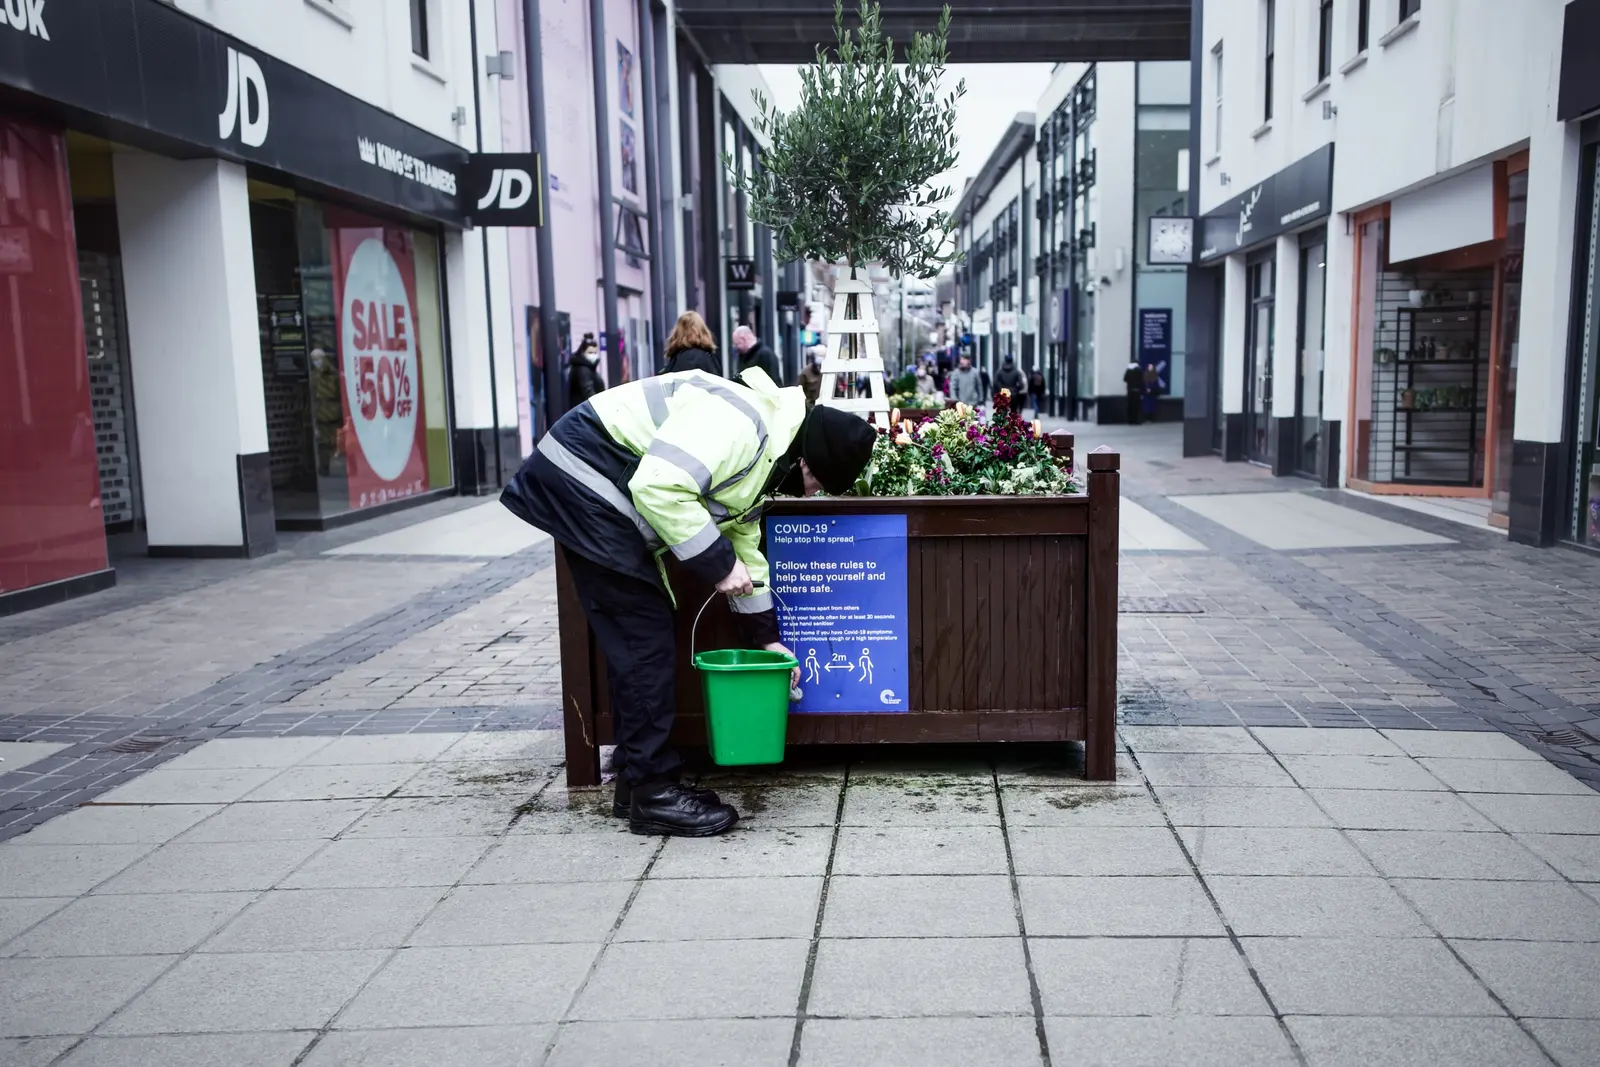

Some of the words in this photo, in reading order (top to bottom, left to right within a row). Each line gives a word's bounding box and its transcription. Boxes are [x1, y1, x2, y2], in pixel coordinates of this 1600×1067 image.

[219, 46, 269, 148] JD
[377, 142, 404, 176] KING
[403, 154, 413, 172] OF
[478, 169, 532, 210] JD
[732, 265, 750, 279] W
[352, 298, 408, 352] SALE
[360, 356, 410, 420] 50%
[397, 400, 412, 418] OFF
[775, 524, 828, 533] COVID-19
[775, 536, 792, 544] Help
[776, 562, 807, 570] Follow
[810, 561, 837, 569] these
[840, 561, 864, 569] rules
[776, 573, 797, 583] help
[800, 573, 823, 582] keep
[826, 572, 864, 582] yourself
[868, 572, 886, 580] and
[777, 585, 807, 593] others
